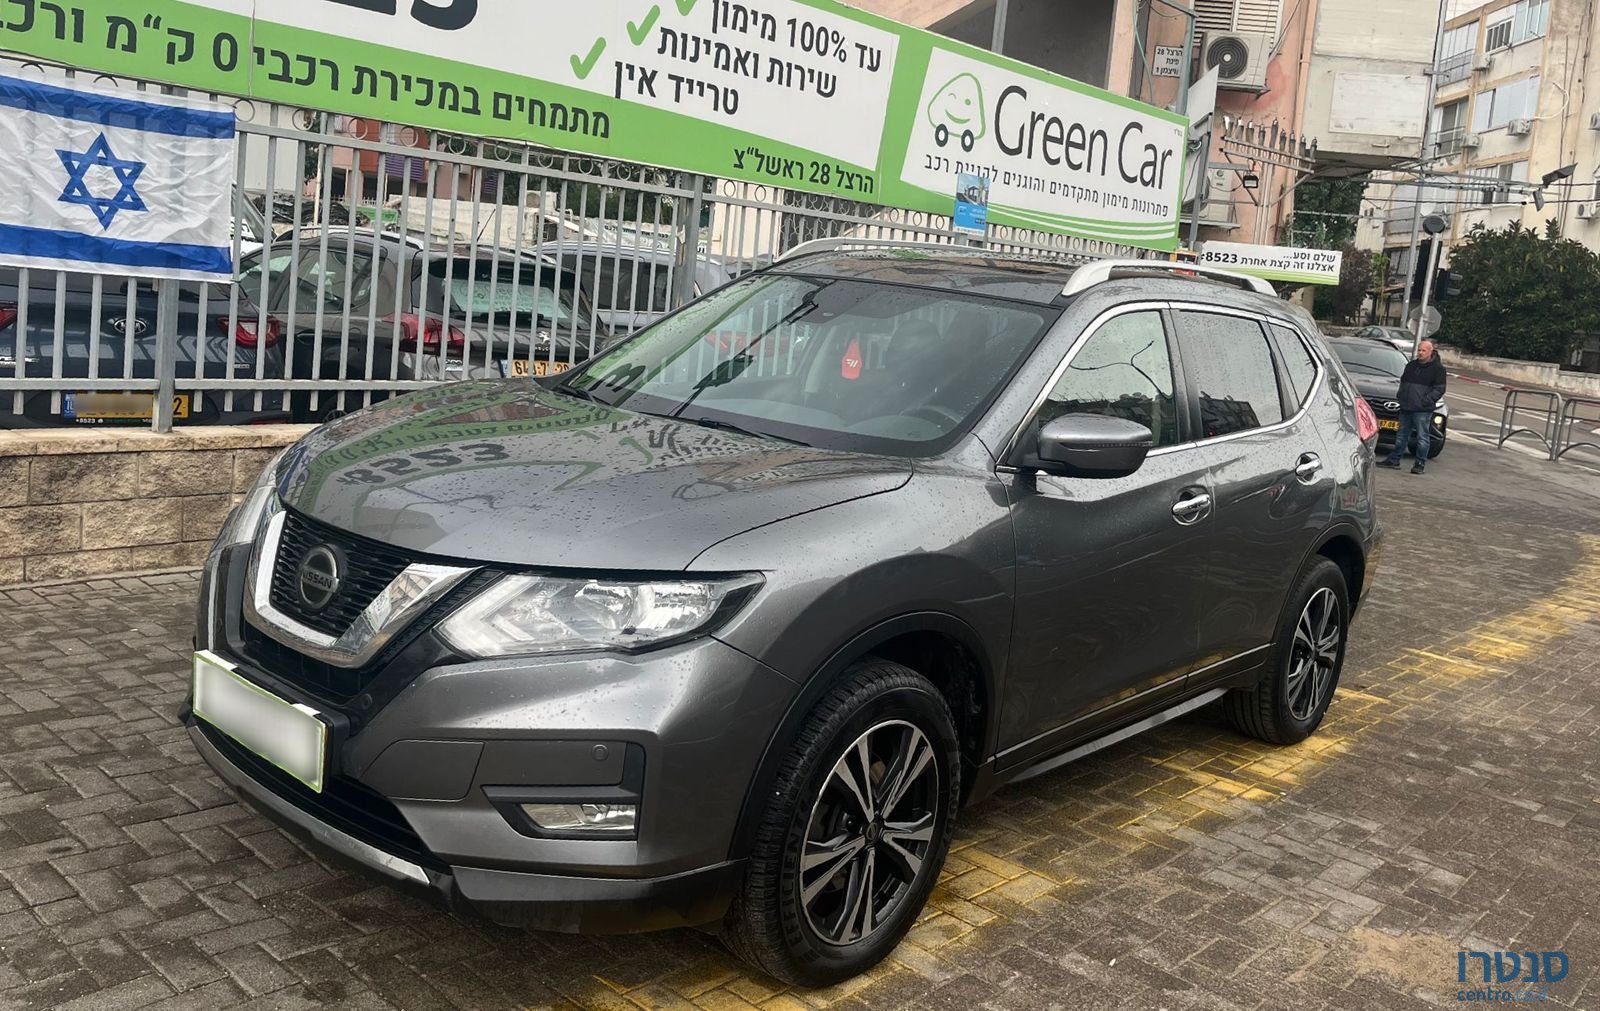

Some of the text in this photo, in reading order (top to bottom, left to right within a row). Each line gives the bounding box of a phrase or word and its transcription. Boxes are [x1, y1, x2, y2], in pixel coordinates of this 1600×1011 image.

[0, 0, 84, 43] ורכ
[712, 0, 881, 73] עד 100% מימון
[212, 32, 238, 72] 0
[657, 26, 837, 98] שירות ואמינות
[253, 46, 339, 91] רכבי
[352, 65, 481, 116] במכירת
[614, 61, 739, 115] טרייד אין
[493, 91, 610, 139] מתמחים
[994, 85, 1173, 190] Green Car
[733, 146, 874, 194] הרצל 28 ראשל"צ
[924, 154, 949, 173] רכב
[1003, 171, 1045, 193] והוגנים
[1049, 181, 1099, 203] מתקדמים
[1102, 192, 1128, 209] מימון
[1131, 199, 1168, 217] פתרונות
[1240, 256, 1268, 267] אחרת
[1270, 258, 1290, 270] קצת
[1293, 262, 1304, 270] זה
[1306, 261, 1335, 272] אצלנו
[1313, 251, 1336, 263] שלם
